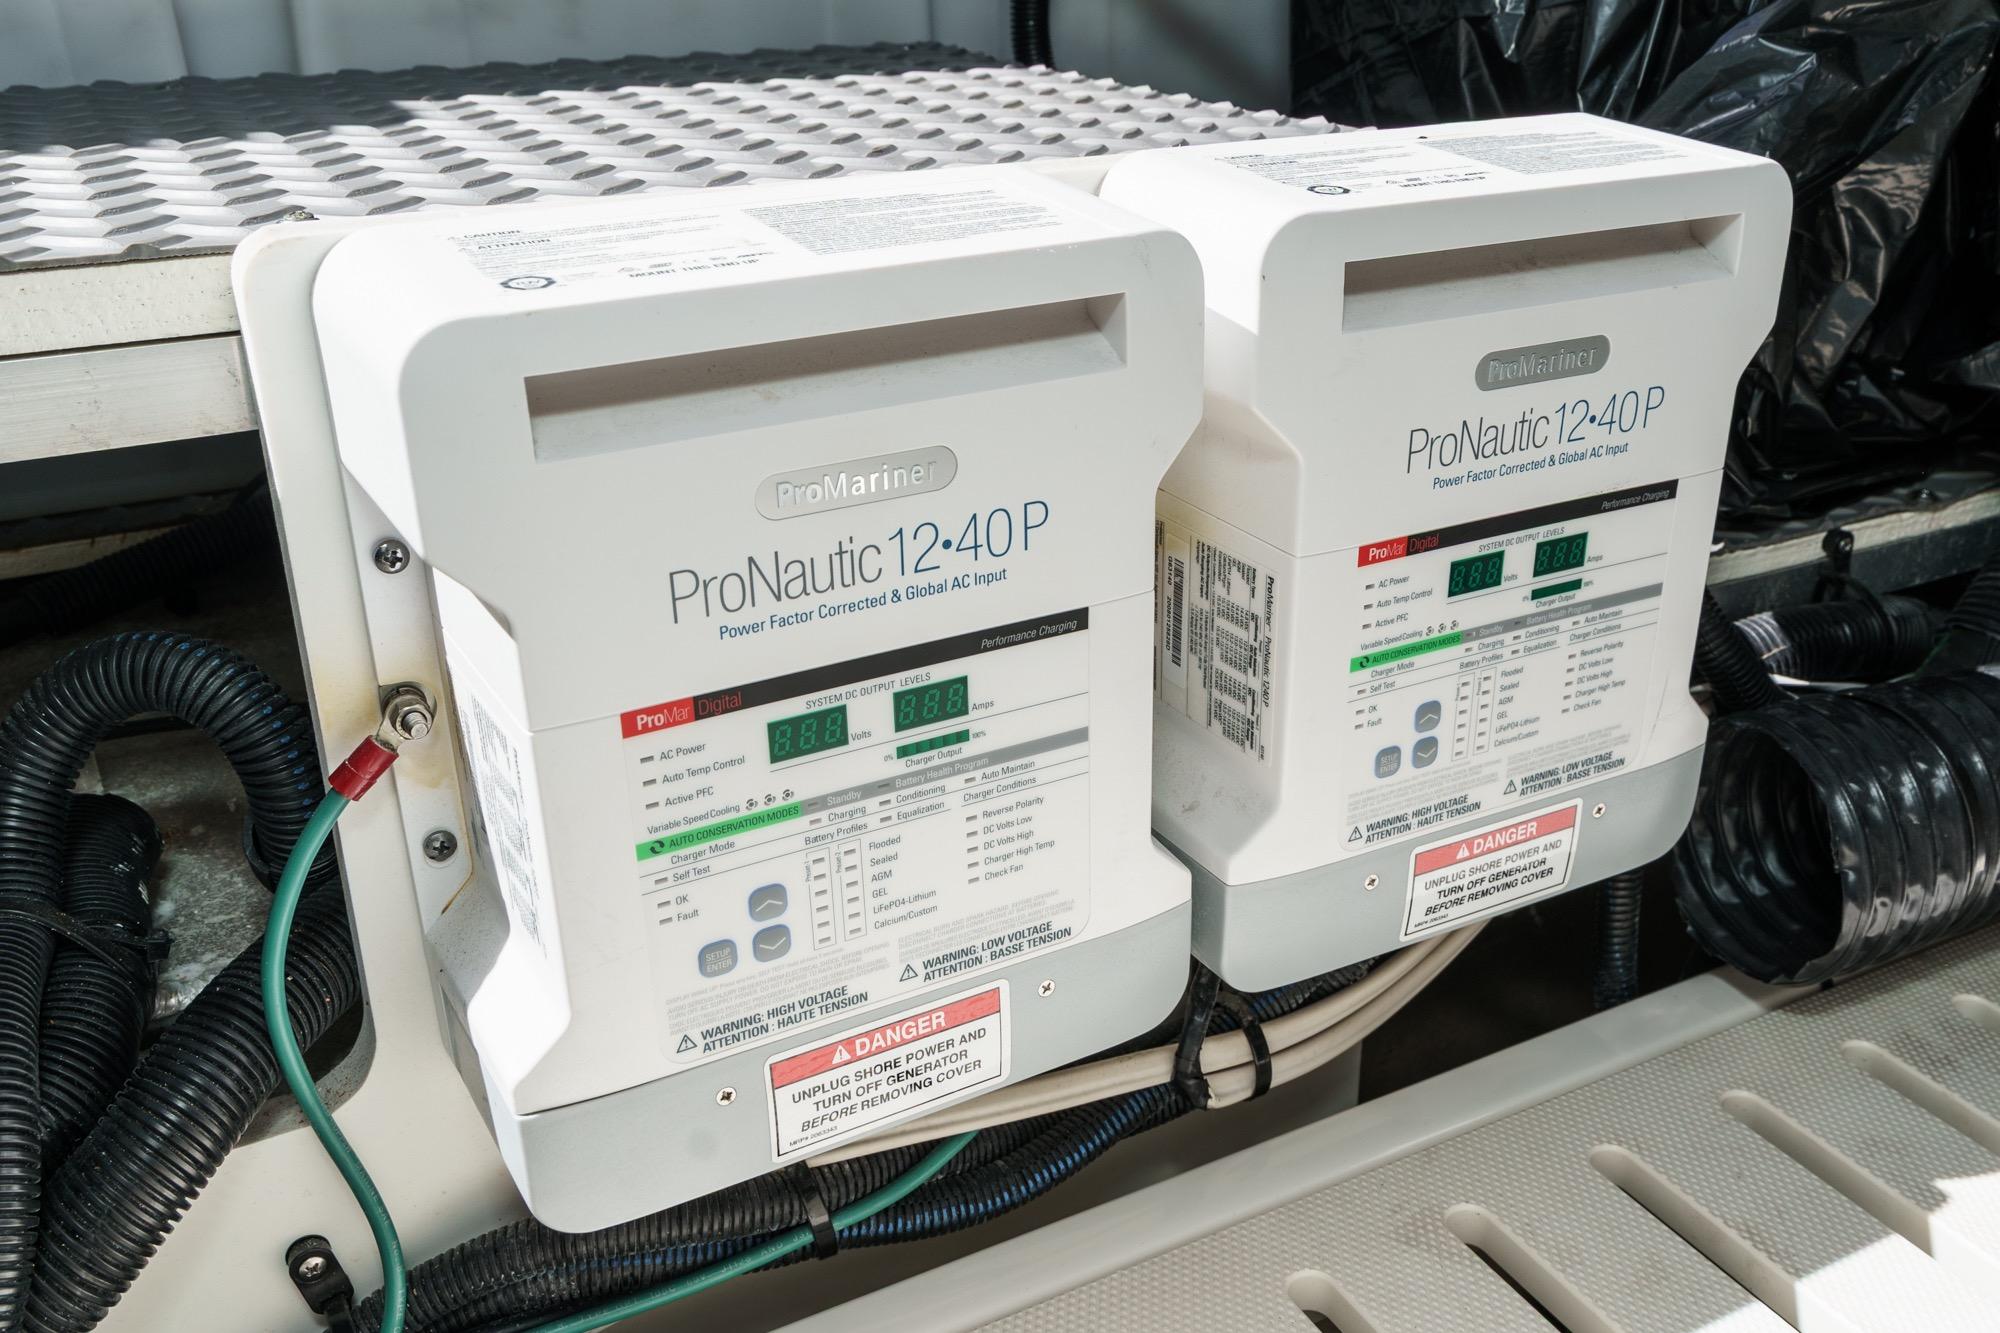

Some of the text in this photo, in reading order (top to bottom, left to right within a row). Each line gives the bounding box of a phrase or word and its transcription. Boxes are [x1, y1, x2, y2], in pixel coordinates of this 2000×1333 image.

[1488, 347, 1599, 383] ProMariner
[1407, 407, 1549, 473] ProNautic
[1642, 385, 1664, 428] P
[1432, 442, 1628, 489] Power Factor Corrected & Global AC Input
[775, 460, 937, 507] ProMariner
[669, 535, 882, 624] ProNautic
[1023, 500, 1048, 550] P
[719, 568, 1006, 640] Power Factor Corrected & Global AC Input
[1265, 575, 1274, 627] ProMariner
[981, 620, 1077, 648] Performance Charging
[1263, 635, 1271, 677] ProNautic
[805, 671, 930, 709] SYSTEM DC OUTPUT LEVELS
[636, 691, 741, 731] ProMar Digital
[971, 700, 994, 711] Amps
[850, 730, 871, 741] Volts
[659, 743, 705, 760] AC Power
[905, 746, 962, 768] Charger Output
[662, 755, 744, 784] Auto Temp Control
[895, 758, 988, 788] Battery Health Program
[981, 761, 1034, 780] Auto Maintain
[1519, 776, 1561, 796] ATTENTION
[1566, 767, 1591, 782] BASSE
[1592, 758, 1625, 773] TENSION
[1521, 751, 1612, 786] WARNING: LOW VOLTAGE
[664, 786, 713, 806] Active PFC
[827, 791, 861, 805] Standby
[896, 784, 945, 801] Conditioning
[963, 777, 1036, 802] Charger Conditions
[647, 804, 740, 834] Variable Speed Cooling
[828, 806, 866, 821] Charging
[897, 802, 944, 820] Equalization
[982, 797, 1043, 818] Reverse Polarity
[1366, 794, 1468, 832] WARNING: HIGH VOLTAGE
[669, 805, 798, 848] AUTO CONSERVATION MODES
[804, 823, 868, 845] Battery Profiles
[983, 816, 1032, 834] DC Volts Low
[1365, 821, 1411, 843] ATTENTION
[1417, 811, 1444, 827] HAUTE
[1445, 801, 1480, 818] TENSION
[868, 834, 900, 850] Flooded
[983, 830, 1033, 850] DC Volts High
[1473, 821, 1536, 854] DANGER
[670, 840, 735, 864] Charger Mode
[870, 851, 898, 866] Sealed
[984, 840, 1054, 865] Charger High Temp
[1424, 839, 1561, 890] UNPLUG SHORE POWER AND
[672, 865, 710, 881] Self Test
[871, 869, 892, 882] AGM
[984, 864, 1023, 880] Check Fan
[1437, 857, 1546, 899] TURN OFF GENERATOR
[675, 894, 688, 905] OK
[872, 887, 887, 898] GEL
[873, 890, 936, 914] LiFePO4-Lithium
[1424, 866, 1553, 916] BEFORE REMOVING COVER
[677, 909, 698, 921] Fault
[874, 905, 937, 929] Calcium/Custom
[705, 947, 730, 961] SETUP
[922, 920, 1052, 970] WARNING: LOW VOLTAGE
[923, 954, 982, 982] ATTENTION
[990, 941, 1024, 960] BASSE
[1026, 926, 1071, 948] TENSION
[706, 958, 732, 972] ENTER
[700, 985, 847, 1040] WARNING: HIGH VOLTAGE
[703, 1022, 768, 1053] ATTENTION
[777, 1007, 815, 1029] HAUTE
[817, 991, 867, 1015] TENSION
[855, 1011, 945, 1056] DANGER
[792, 1027, 986, 1103] UNPLUG SHORE POWER AND
[812, 1049, 967, 1111] TURN OFF GENERATOR
[801, 1059, 981, 1132] BEFORE REMOVING COVER
